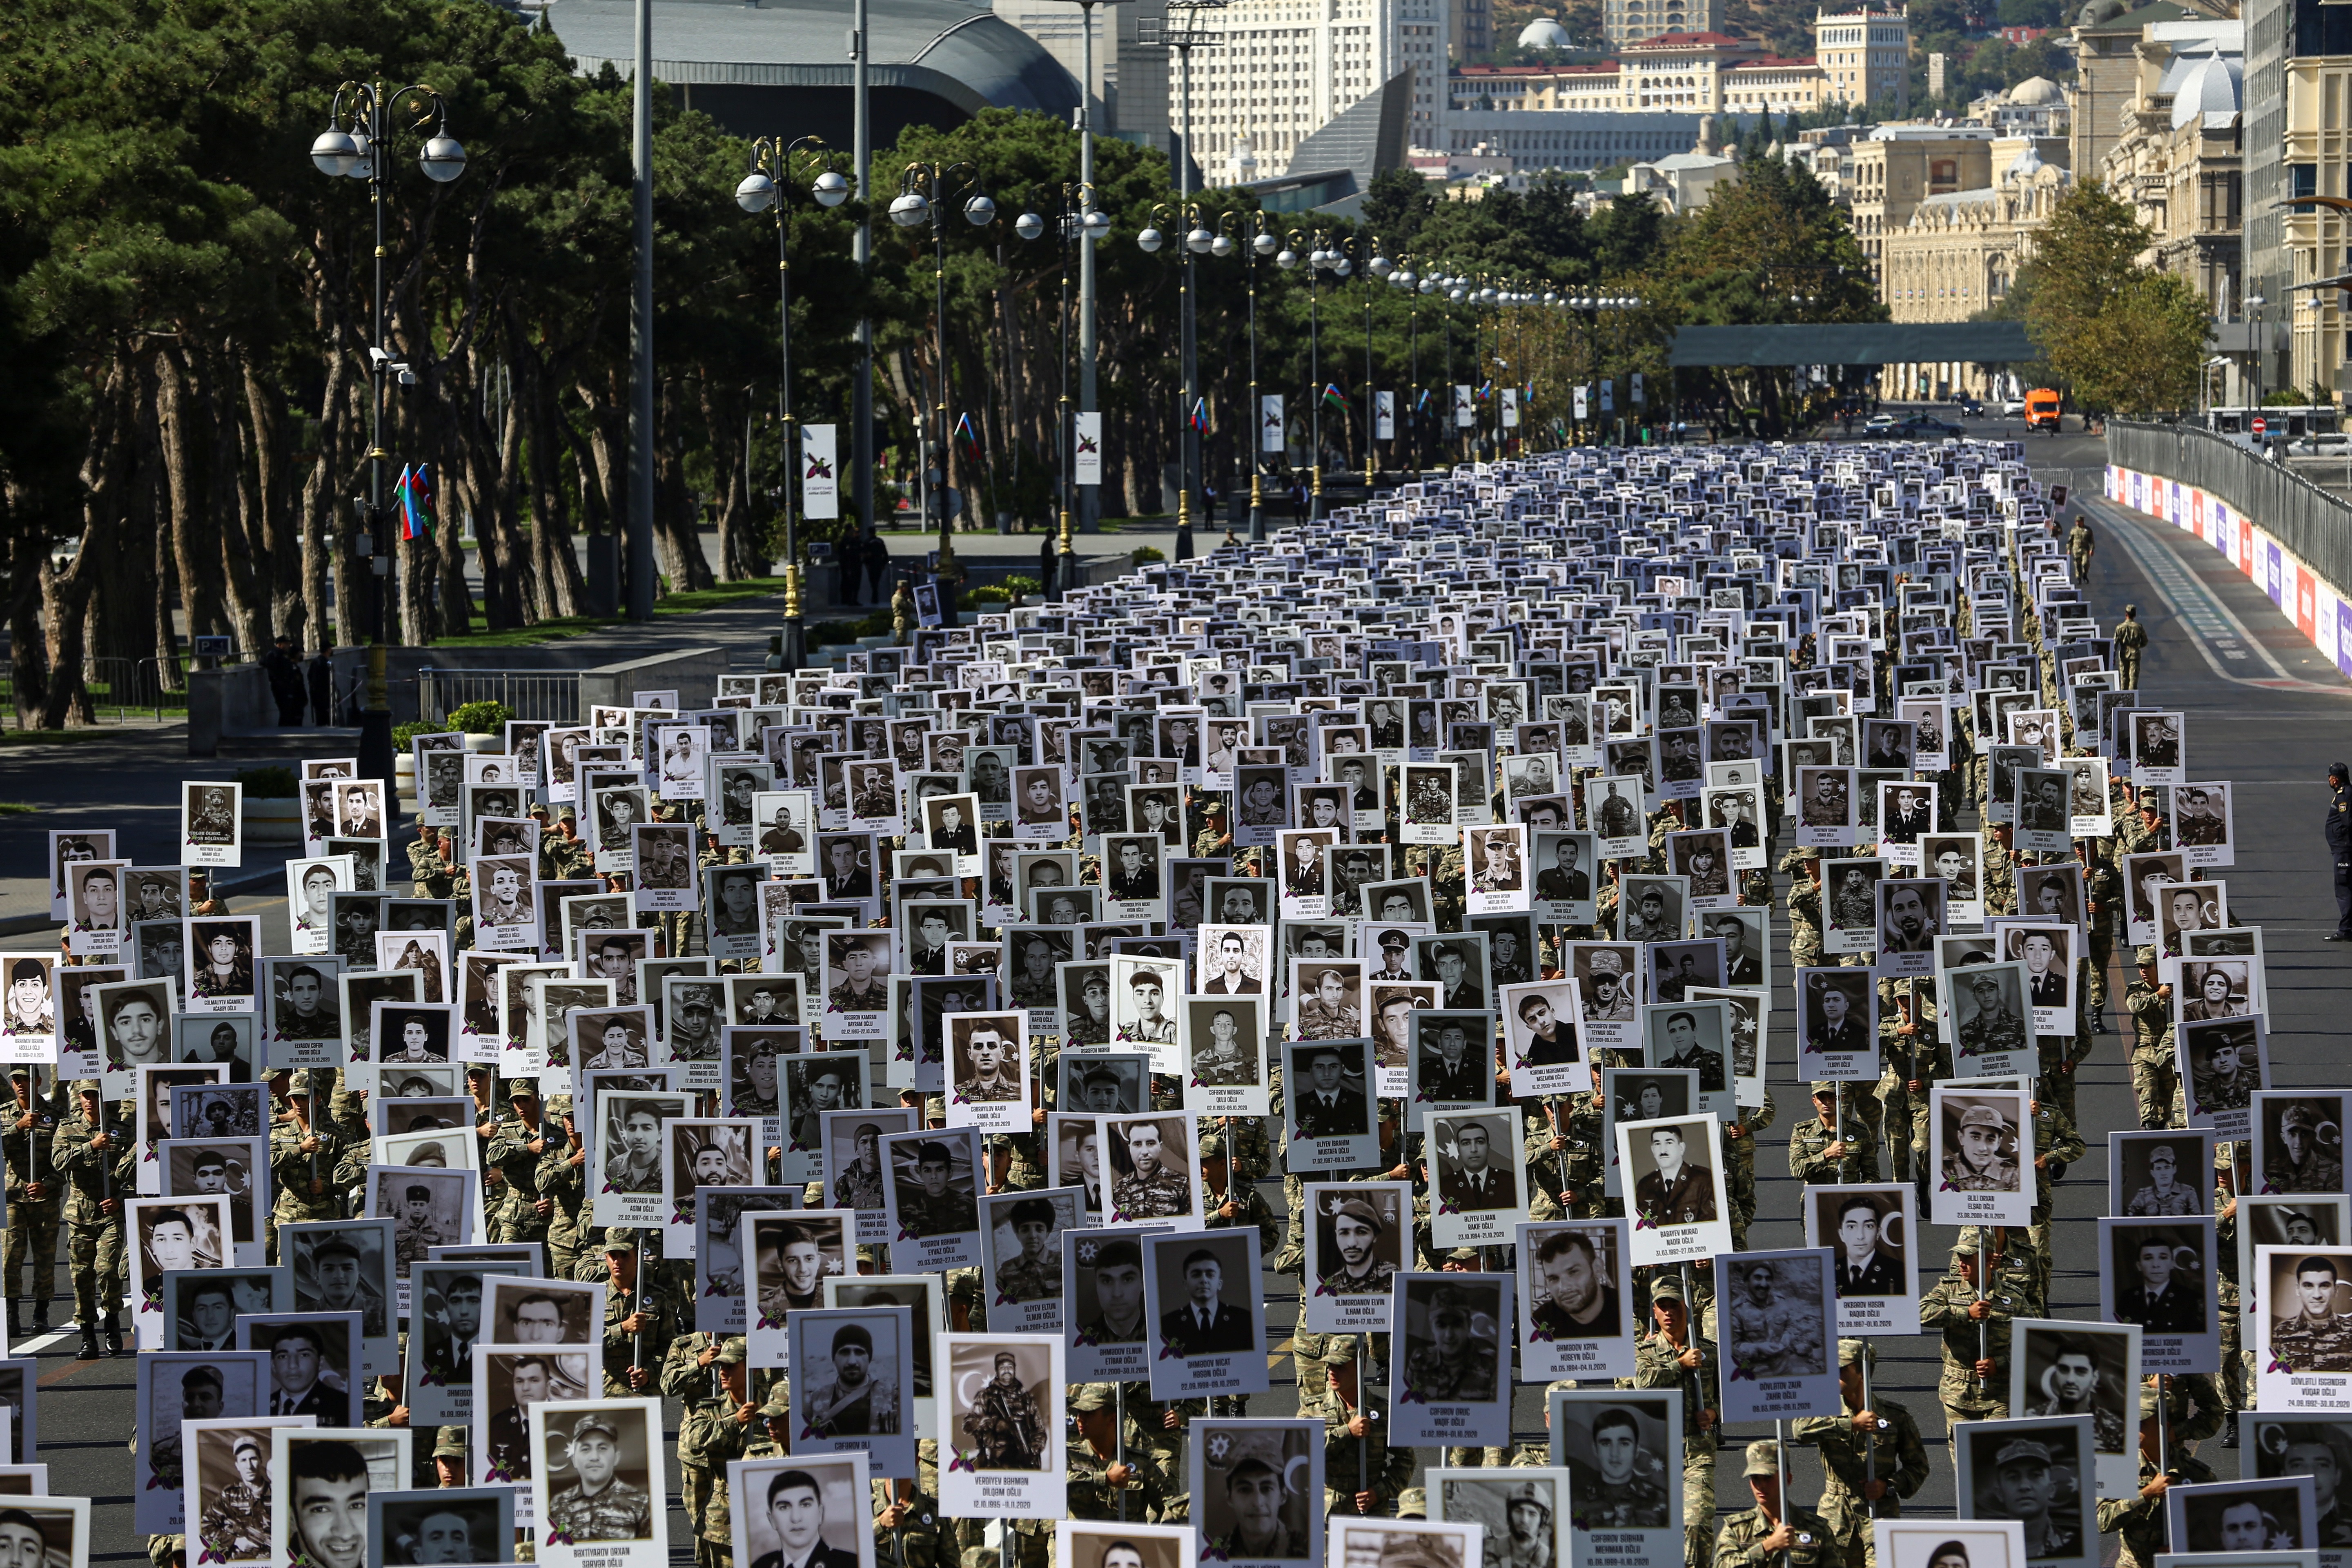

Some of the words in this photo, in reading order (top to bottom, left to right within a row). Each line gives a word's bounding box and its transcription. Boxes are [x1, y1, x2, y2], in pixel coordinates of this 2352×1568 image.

[920, 1240, 940, 1248] BƏŞİROV
[940, 1237, 961, 1246] RƏHMAN
[927, 1247, 942, 1256] EYVAZ
[1026, 1313, 1042, 1321] ELNUR
[1043, 1311, 1055, 1319] OĞLU
[1867, 1309, 1880, 1317] OĞLU
[1099, 1348, 1125, 1356] ƏHMƏDOV
[1556, 1344, 1582, 1352] ƏHMƏDOV
[1105, 1357, 1122, 1365] ETİBAR
[1124, 1356, 1137, 1364] OĞLU
[1560, 1353, 1581, 1361] HÜSEYN
[1582, 1352, 1595, 1361] OĞLU
[1187, 1359, 1214, 1369] ƏHMƏDOV
[1215, 1358, 1230, 1367] NİCAT
[1193, 1370, 1211, 1379] HƏSƏN
[1212, 1368, 1226, 1377] OĞLU
[1782, 1390, 1797, 1400] OĞLU
[2321, 1387, 2336, 1396] OĞLU
[1450, 1417, 1465, 1426] OĞLU
[975, 1476, 1002, 1485] VERDİYEV
[1003, 1477, 1029, 1486] BƏHMƏN
[982, 1487, 1004, 1497] DİLQƏM
[1007, 1487, 1021, 1497] OĞLU
[973, 1500, 1000, 1508] 12.10.1995
[573, 1548, 608, 1558] BƏXTİYAROV
[610, 1547, 630, 1556] ORXAN
[582, 1559, 605, 1568] SƏRVƏR
[607, 1558, 622, 1568] OĞLU
